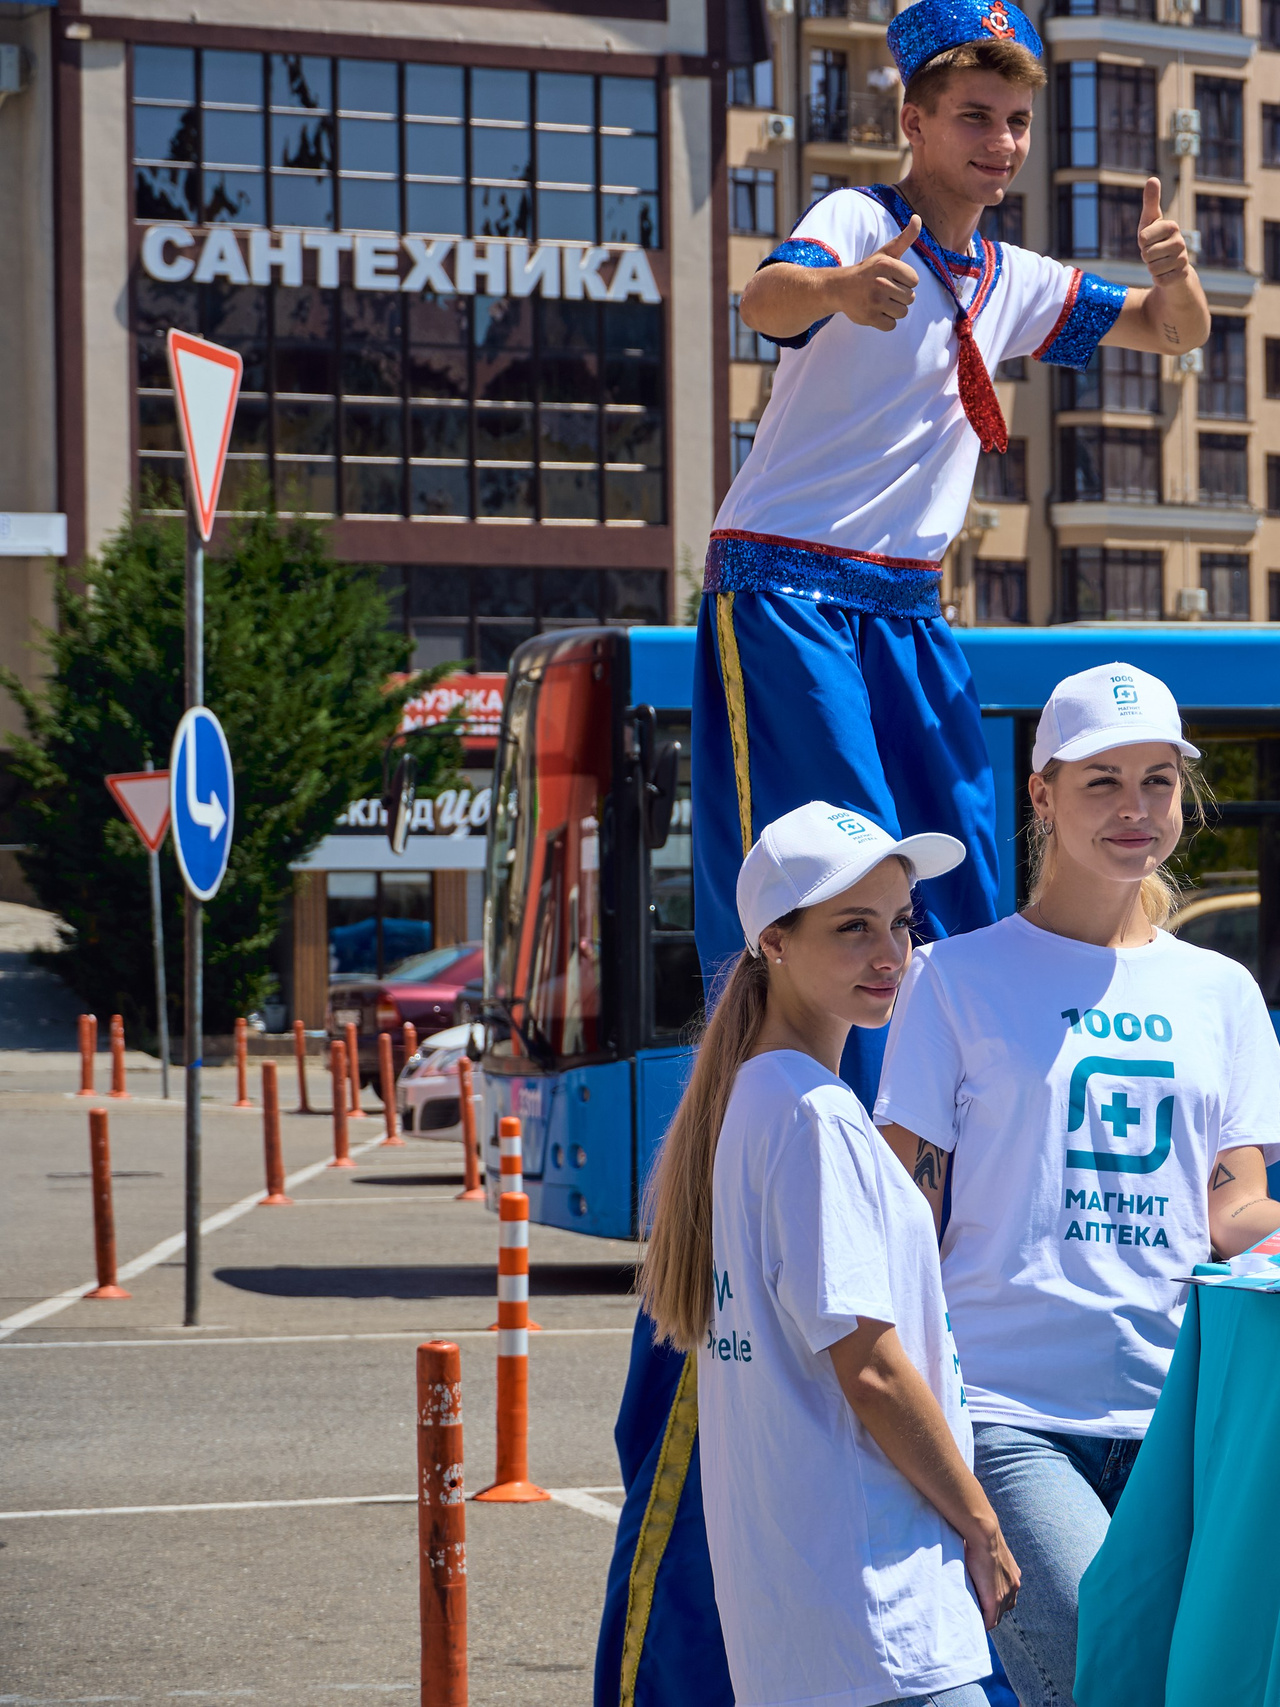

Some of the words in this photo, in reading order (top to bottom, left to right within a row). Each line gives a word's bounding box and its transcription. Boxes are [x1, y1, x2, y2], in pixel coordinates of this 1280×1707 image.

[140, 223, 663, 304] САНТЕХНИКА
[1110, 675, 1134, 683] 1000
[1061, 1008, 1173, 1043] 1000
[1065, 1188, 1169, 1217] МАГНИТ
[1064, 1220, 1170, 1249] АПТЕКА
